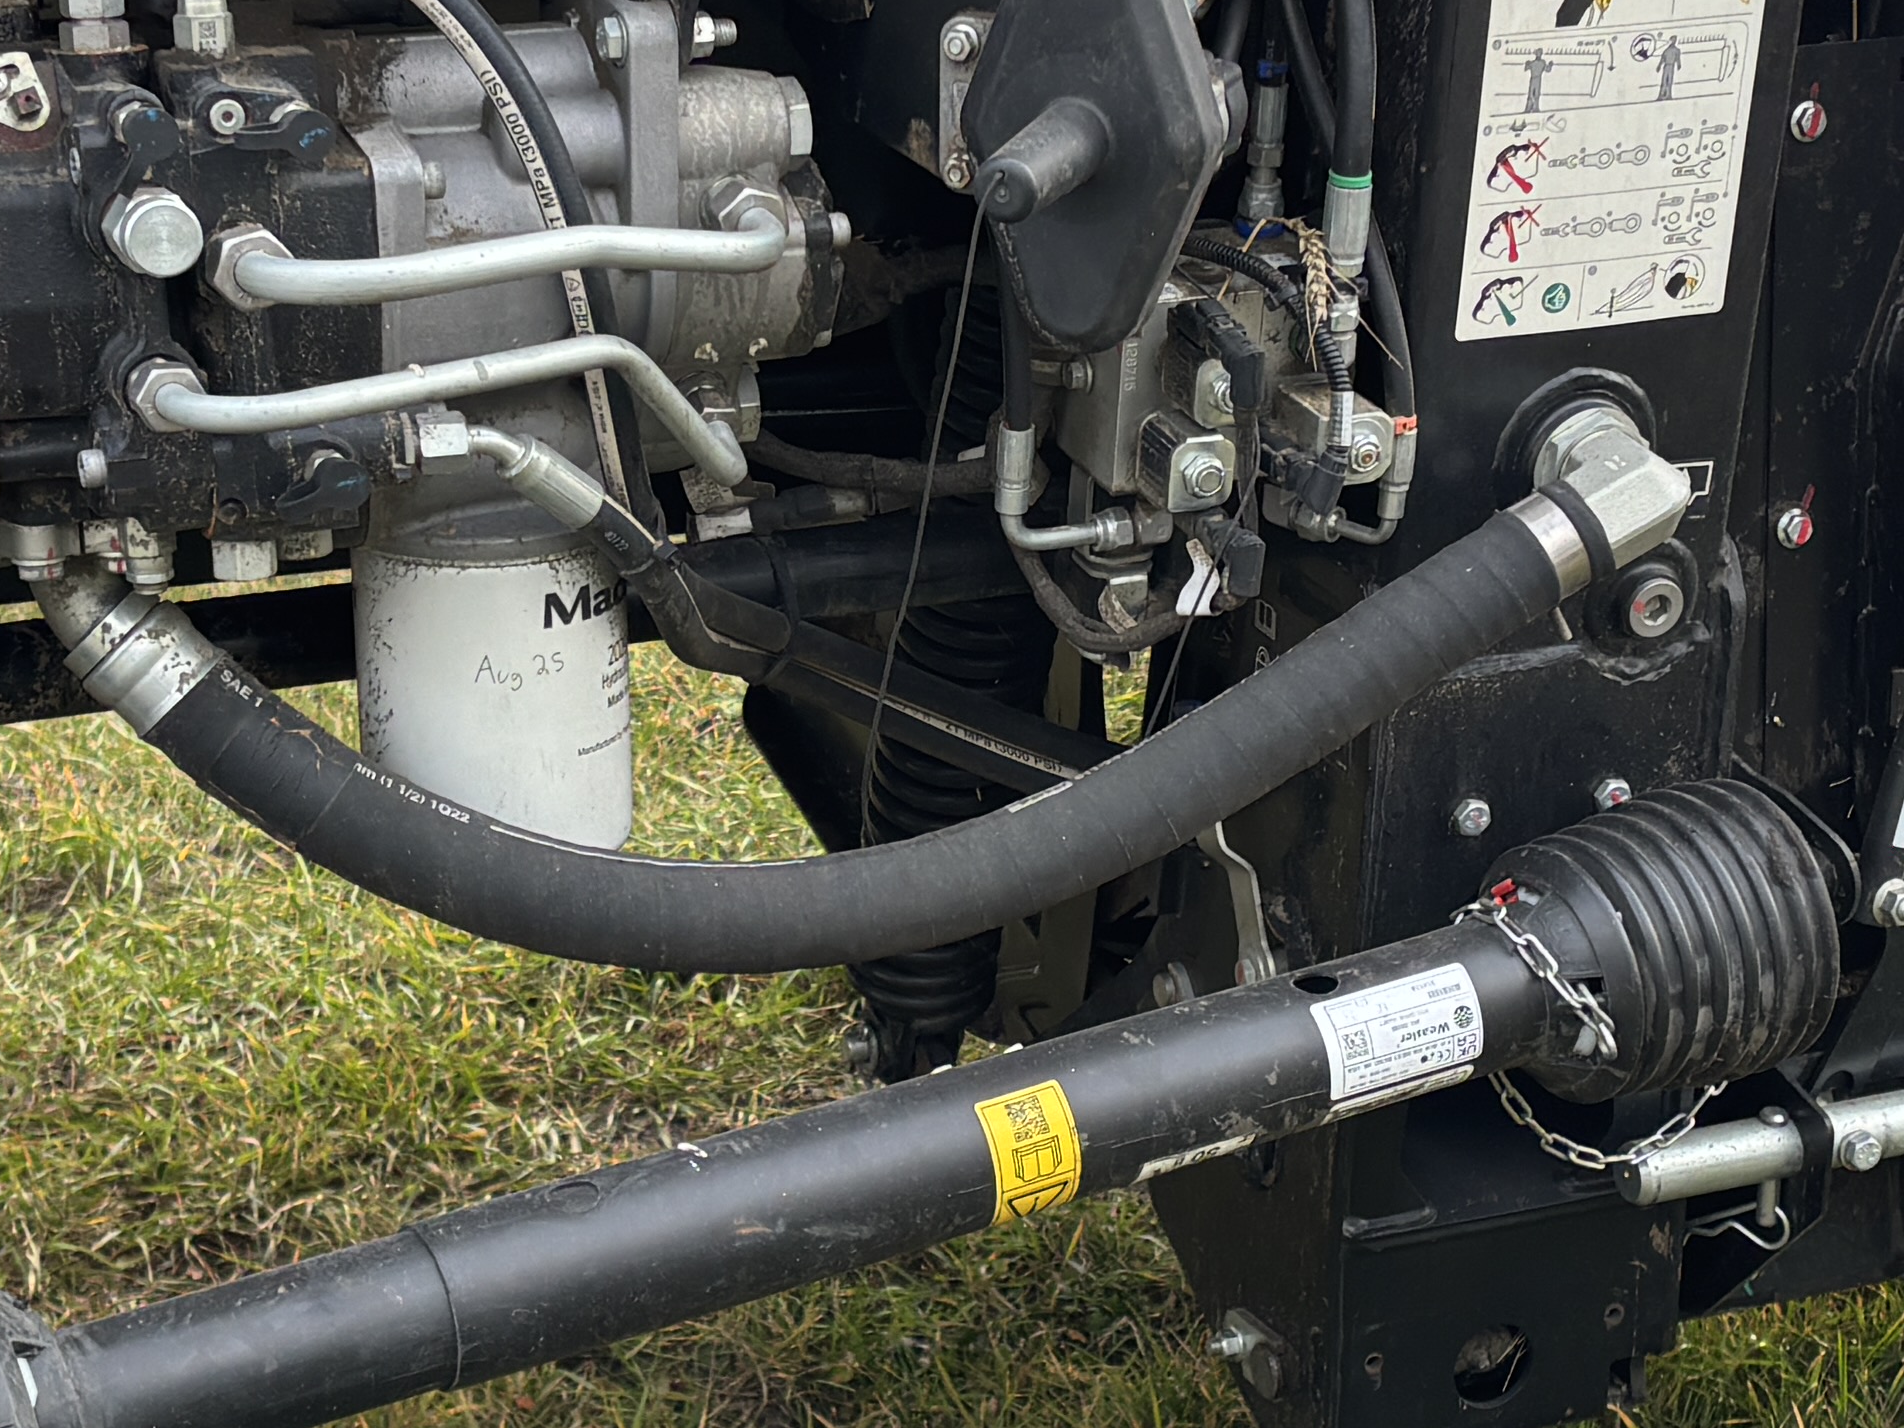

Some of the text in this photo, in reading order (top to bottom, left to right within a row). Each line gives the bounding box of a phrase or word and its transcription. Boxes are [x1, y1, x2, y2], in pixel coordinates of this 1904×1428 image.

[479, 66, 512, 114] PSI)
[503, 109, 540, 169] (3000
[531, 166, 560, 212] MPa
[219, 667, 252, 701] SAE
[475, 651, 565, 692] Aug 25
[991, 739, 1033, 765] (3000
[1032, 755, 1064, 775] PSI)
[430, 798, 471, 825] 1Q22
[1400, 1021, 1450, 1043] Weasler
